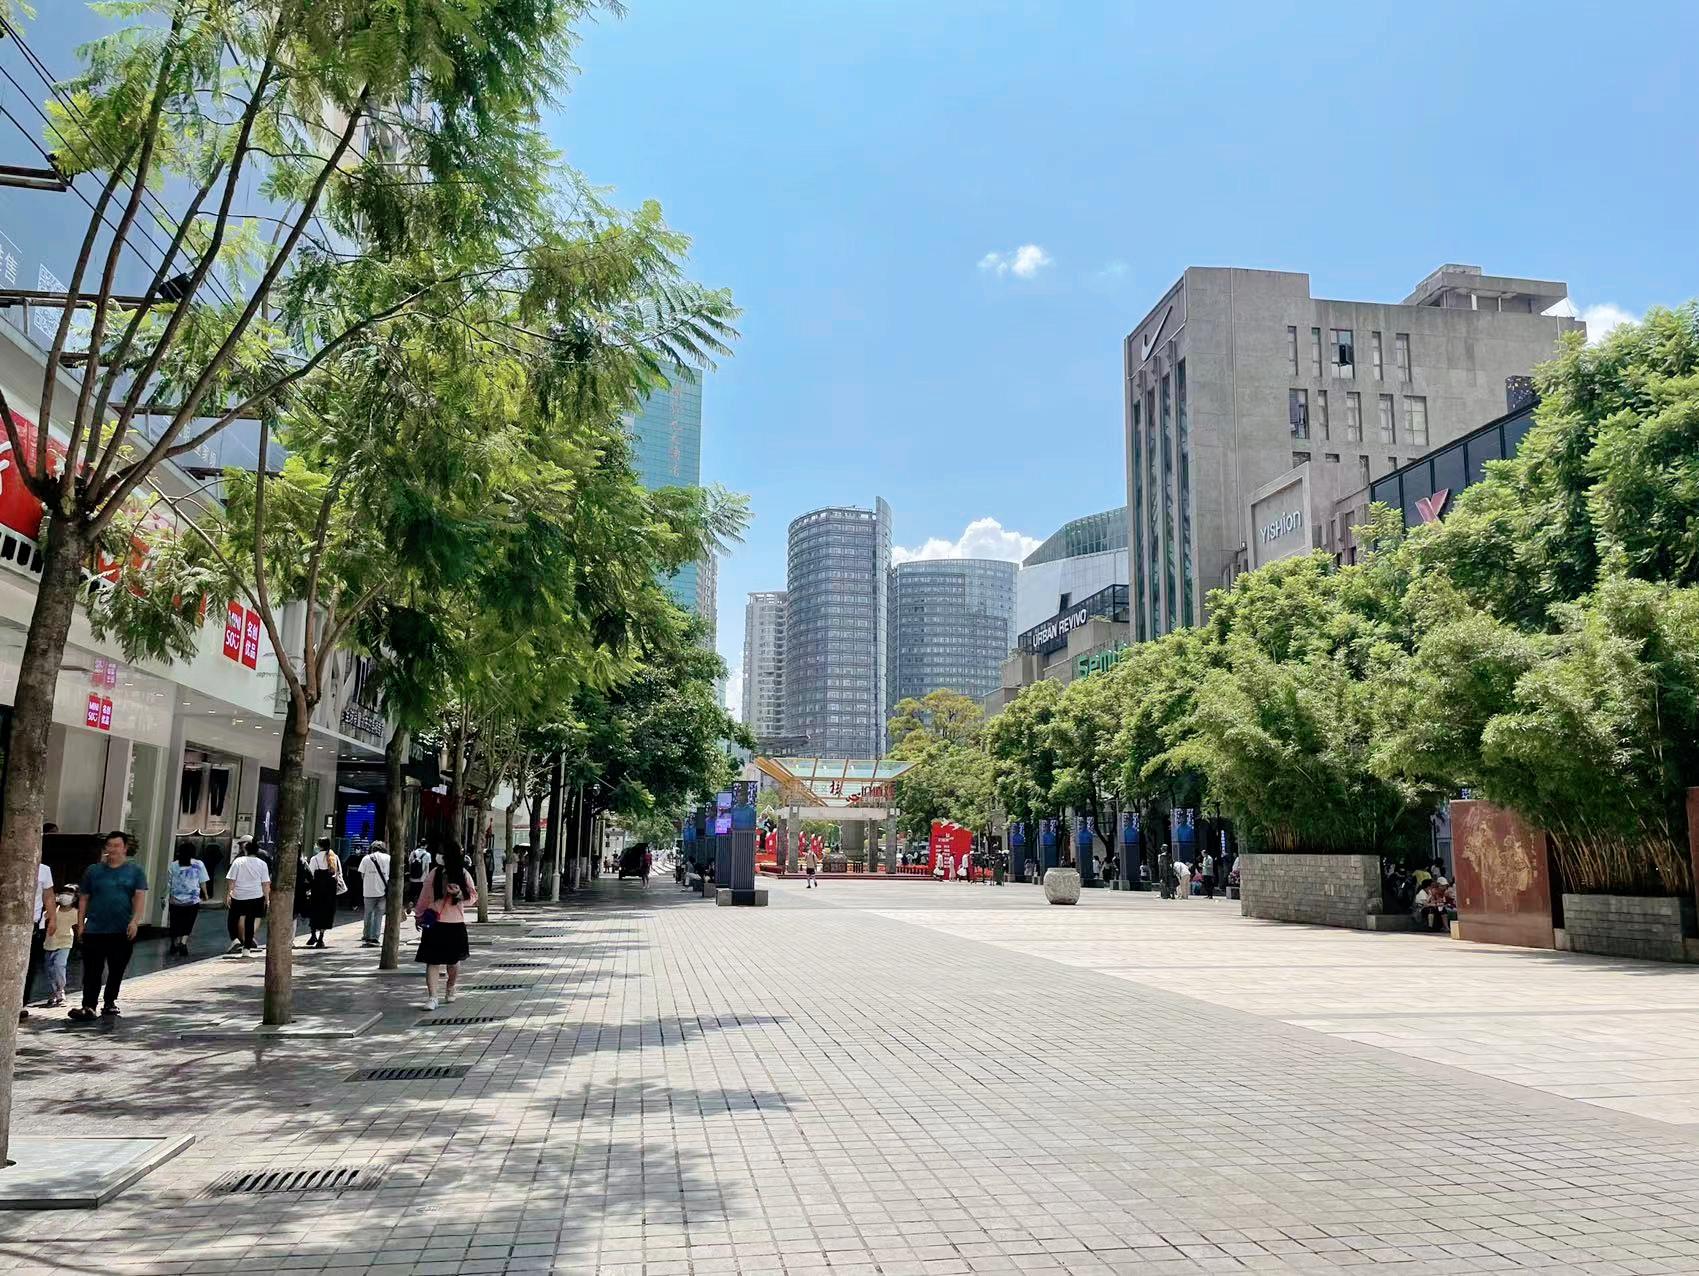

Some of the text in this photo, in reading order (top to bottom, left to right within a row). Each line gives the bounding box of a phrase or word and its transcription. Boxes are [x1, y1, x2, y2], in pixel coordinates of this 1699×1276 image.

[1260, 511, 1302, 543] YISHion
[228, 610, 242, 631] MINI
[1033, 609, 1087, 647] URBAN REVIVO
[247, 621, 259, 641] 名创
[245, 640, 256, 660] 优品
[89, 701, 100, 711] MINI
